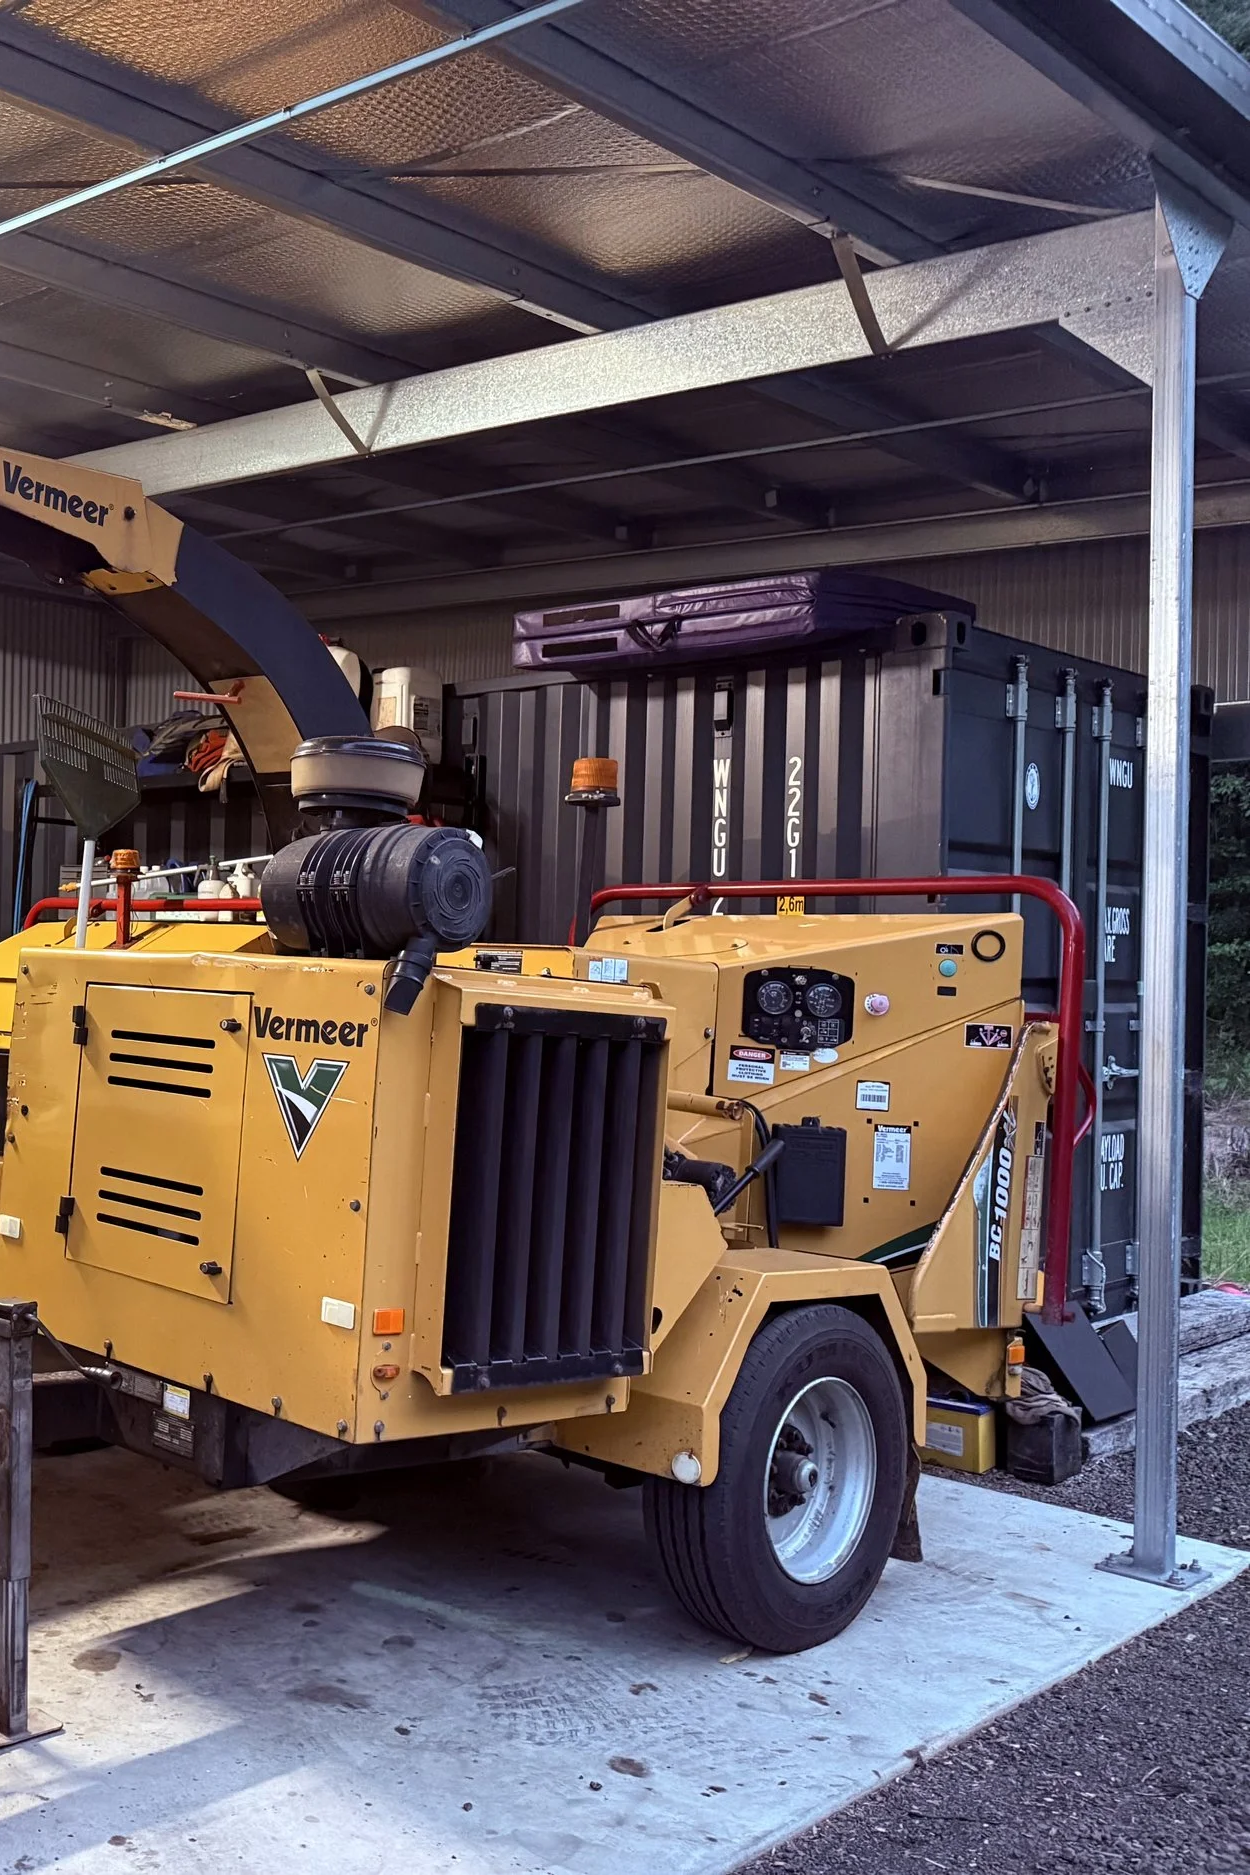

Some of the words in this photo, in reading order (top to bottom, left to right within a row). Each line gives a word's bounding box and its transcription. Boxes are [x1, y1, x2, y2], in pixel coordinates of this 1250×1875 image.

[3, 460, 109, 527] Vermeer
[1110, 757, 1133, 789] WNGU
[713, 758, 731, 877] WNGU
[787, 756, 802, 878] 22G1
[778, 897, 805, 916] 2,6m
[253, 1006, 369, 1047] Vermeer
[738, 1051, 766, 1059] DANGER
[877, 1125, 906, 1134] Vermeer
